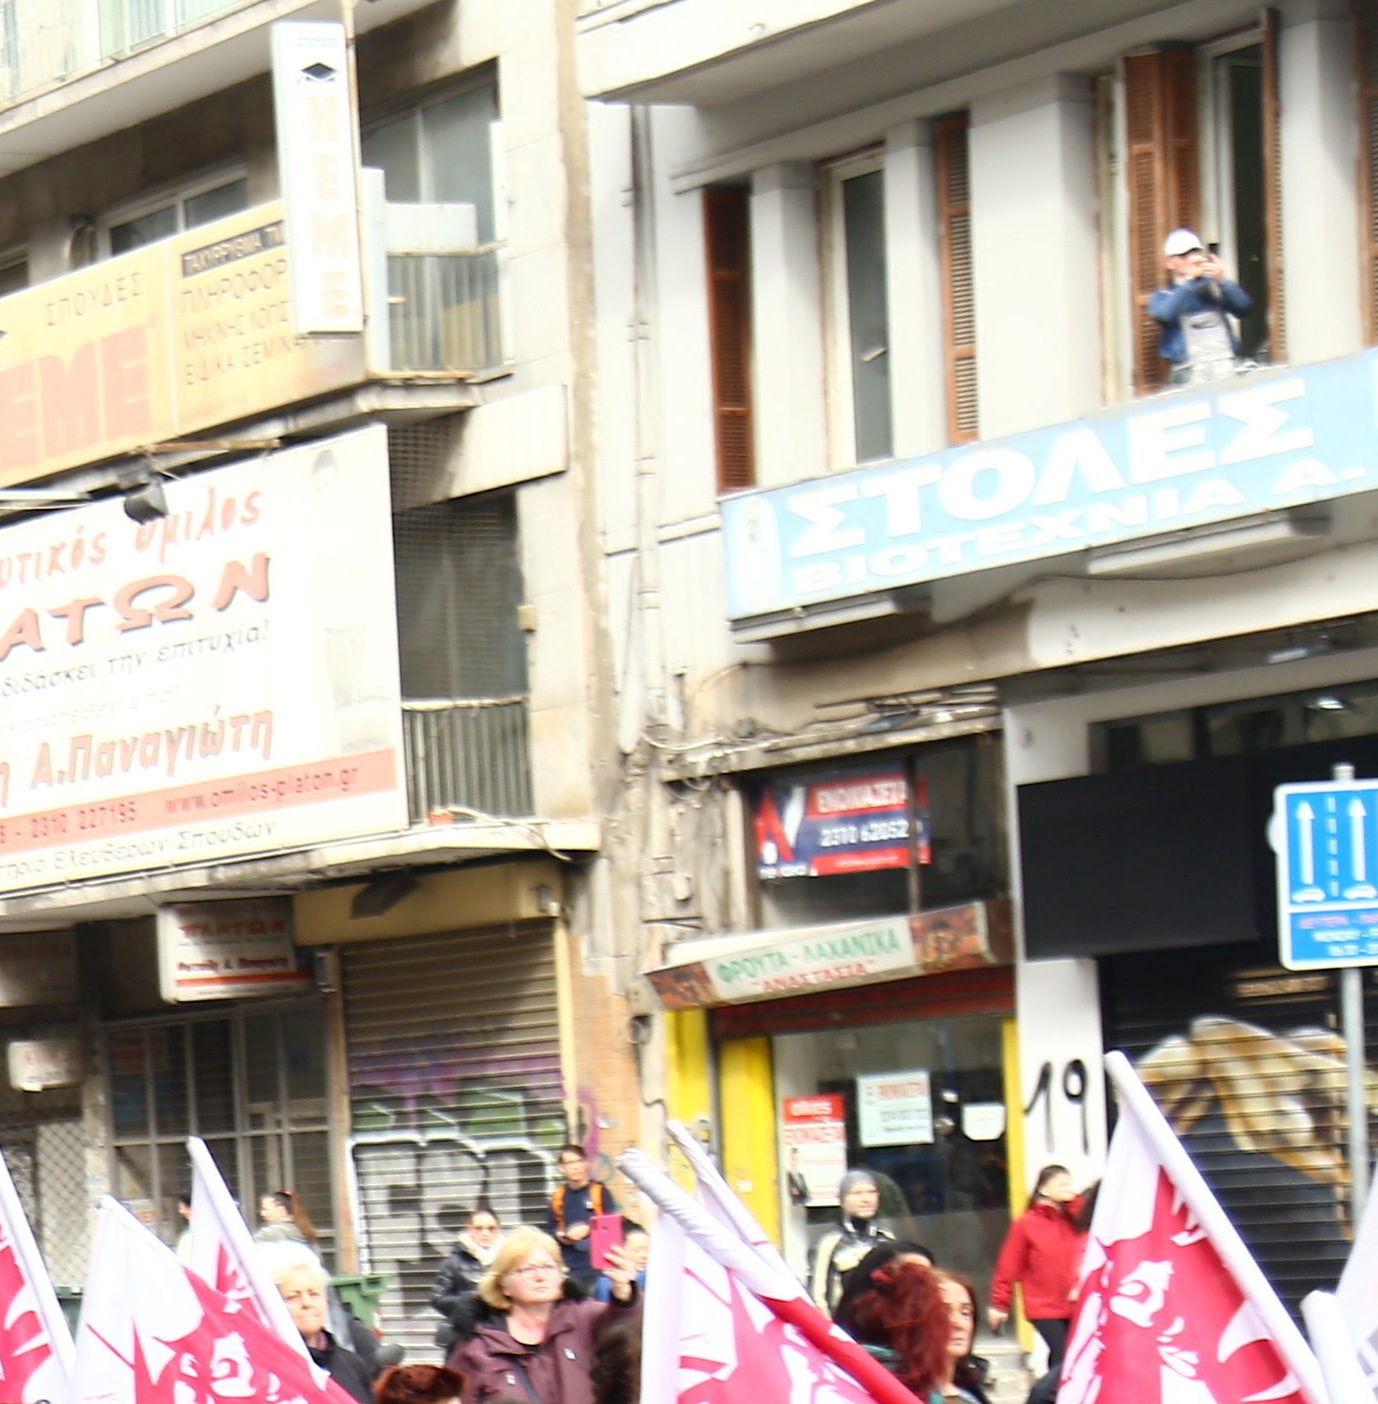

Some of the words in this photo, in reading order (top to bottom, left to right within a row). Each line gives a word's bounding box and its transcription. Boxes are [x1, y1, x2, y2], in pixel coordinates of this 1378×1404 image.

[45, 271, 143, 327] ΣΠΟΥΔΕΣ
[182, 257, 289, 316] ΠΛΗΡΟΦΟΡ
[788, 378, 1314, 558] ΣΤΟΛΕΣ
[792, 478, 1242, 597] ΒΙΟΤΕΧΝΙΑ
[717, 951, 790, 983] ΦΡΟΥΤΑ
[1024, 1058, 1090, 1156] 19
